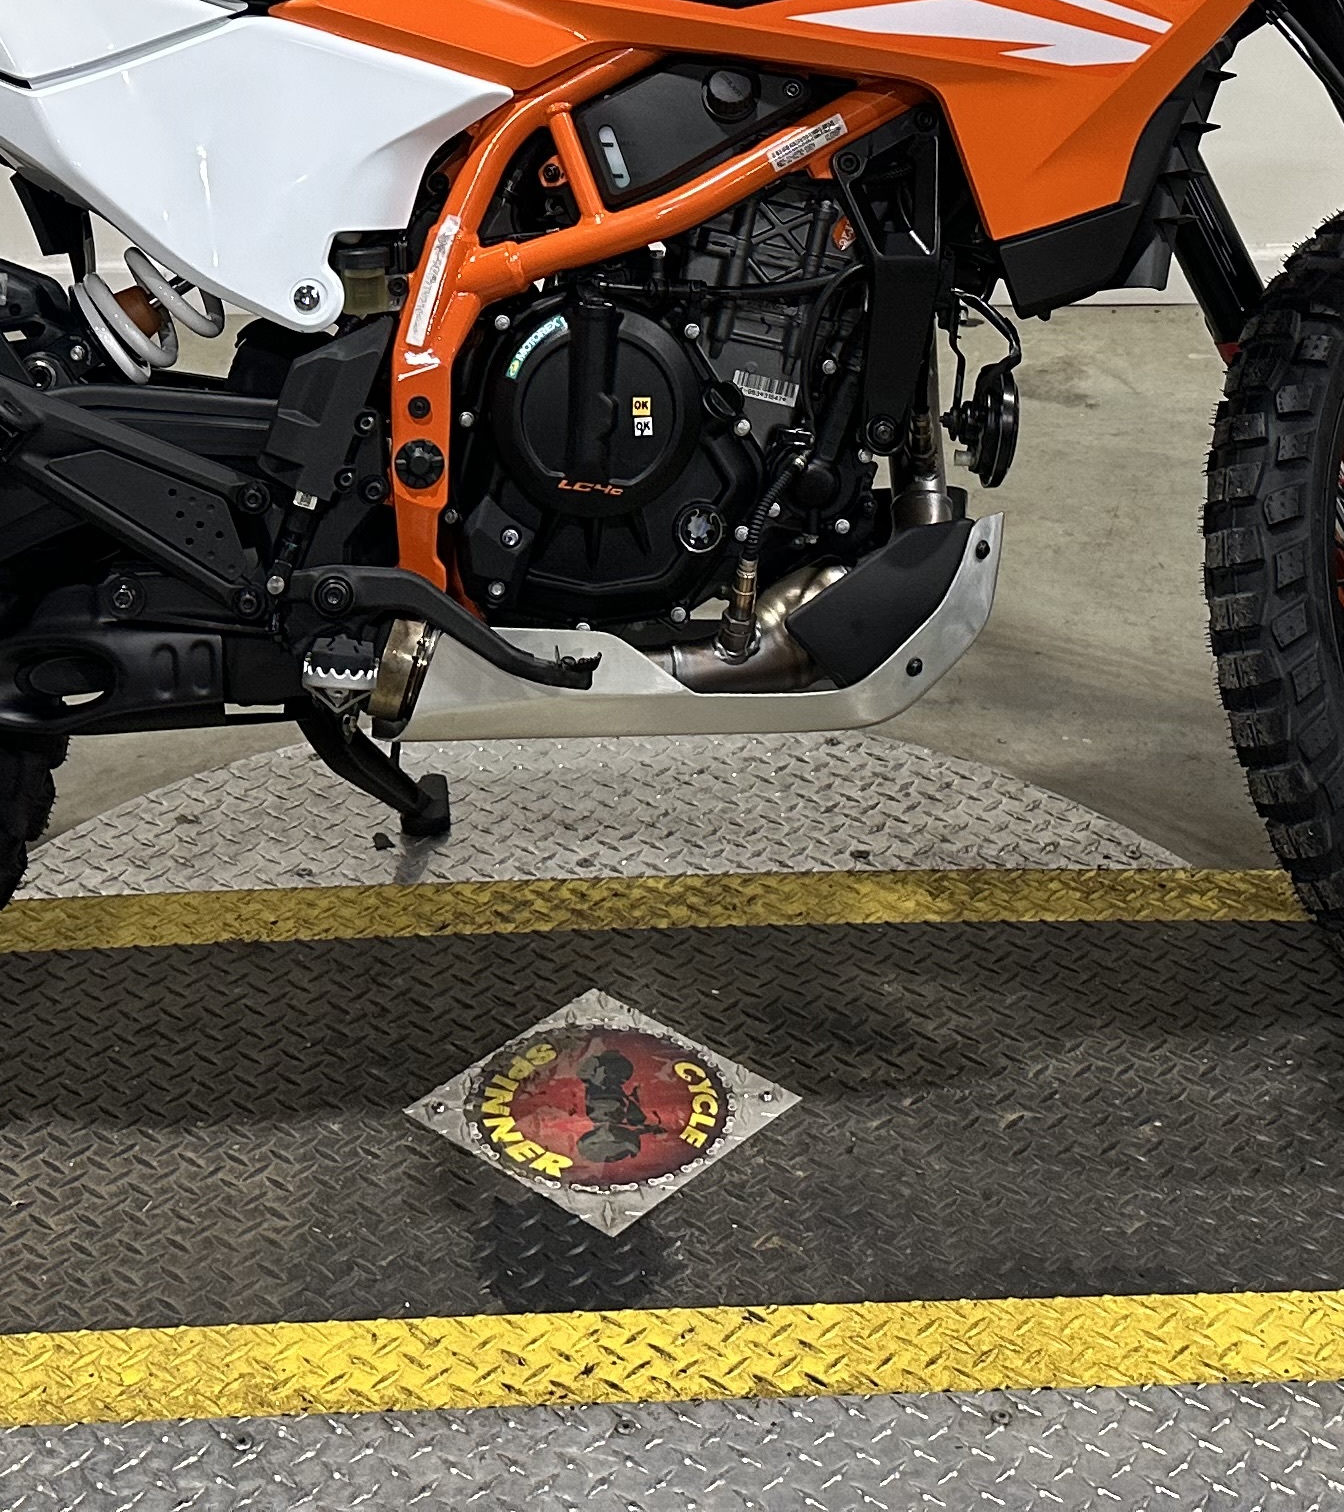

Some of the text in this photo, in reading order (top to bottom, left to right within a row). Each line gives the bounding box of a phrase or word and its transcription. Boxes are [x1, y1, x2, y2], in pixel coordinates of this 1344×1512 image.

[516, 316, 561, 362] MOTOREX
[634, 400, 649, 410] OK
[636, 421, 651, 432] OK
[480, 1043, 574, 1178] SPINNER
[674, 1061, 720, 1149] CYCLE
